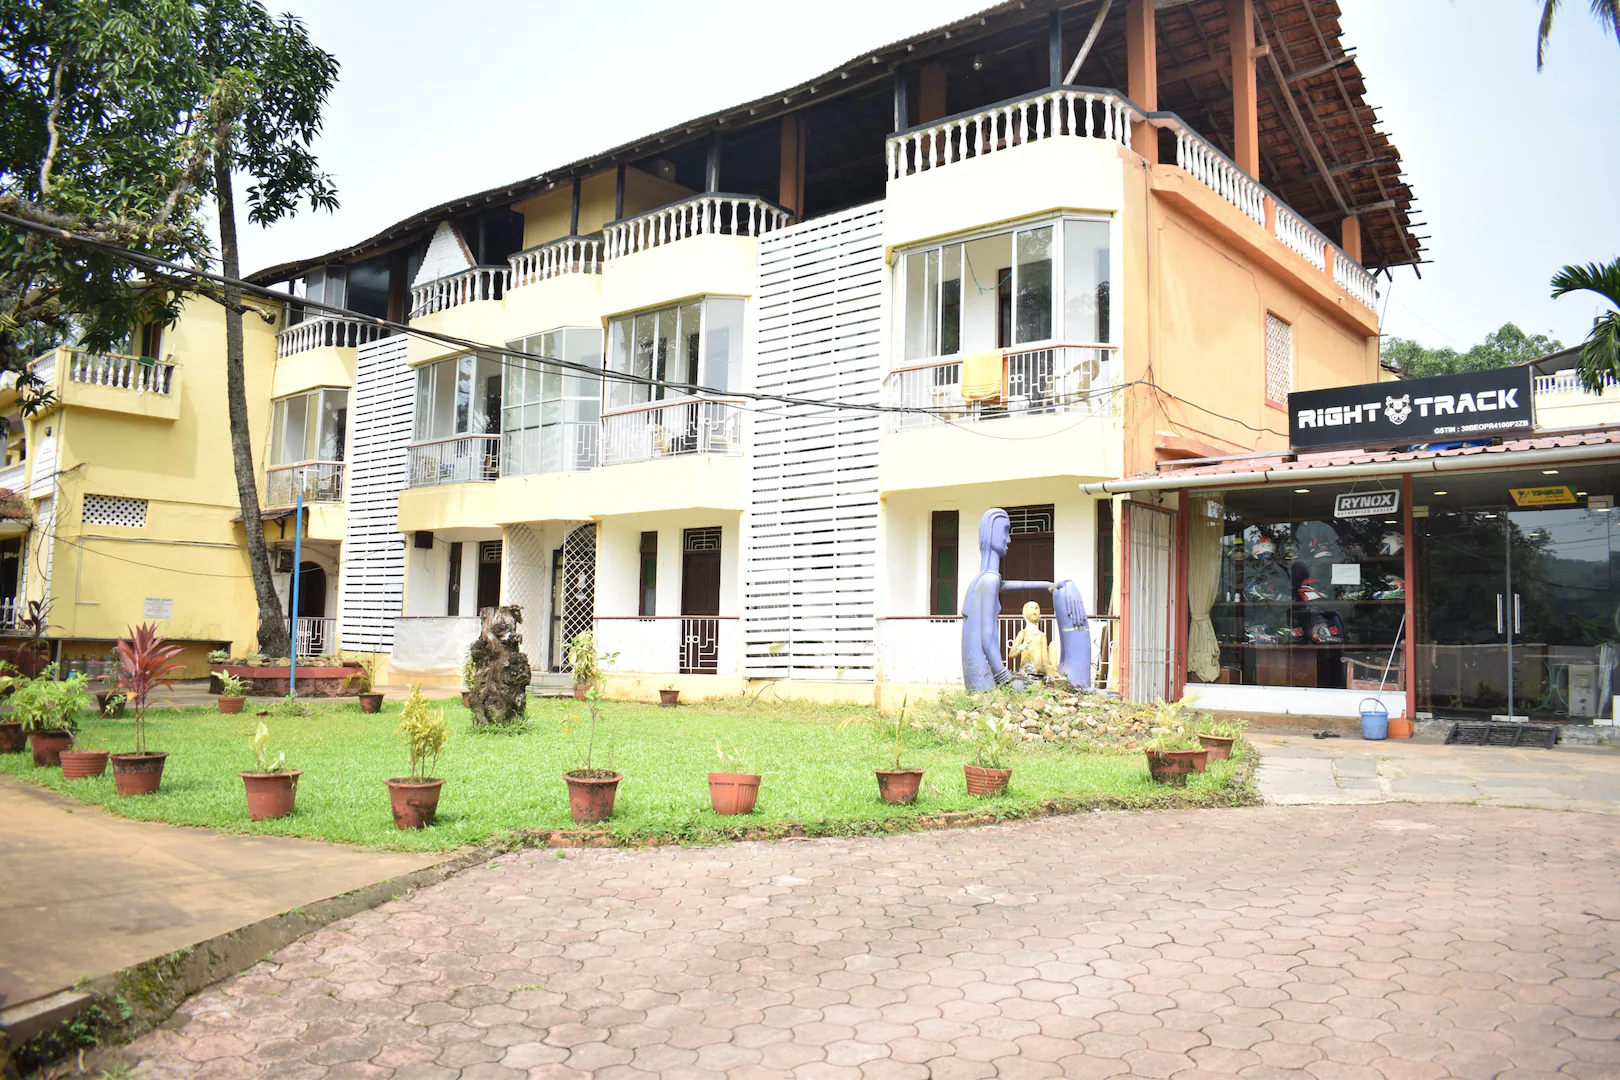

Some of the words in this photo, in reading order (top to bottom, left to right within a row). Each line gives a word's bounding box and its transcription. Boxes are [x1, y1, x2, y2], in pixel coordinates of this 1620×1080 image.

[1414, 388, 1519, 417] TRACK
[1434, 426, 1456, 434] GSTIN
[1341, 494, 1392, 509] RYNOX
